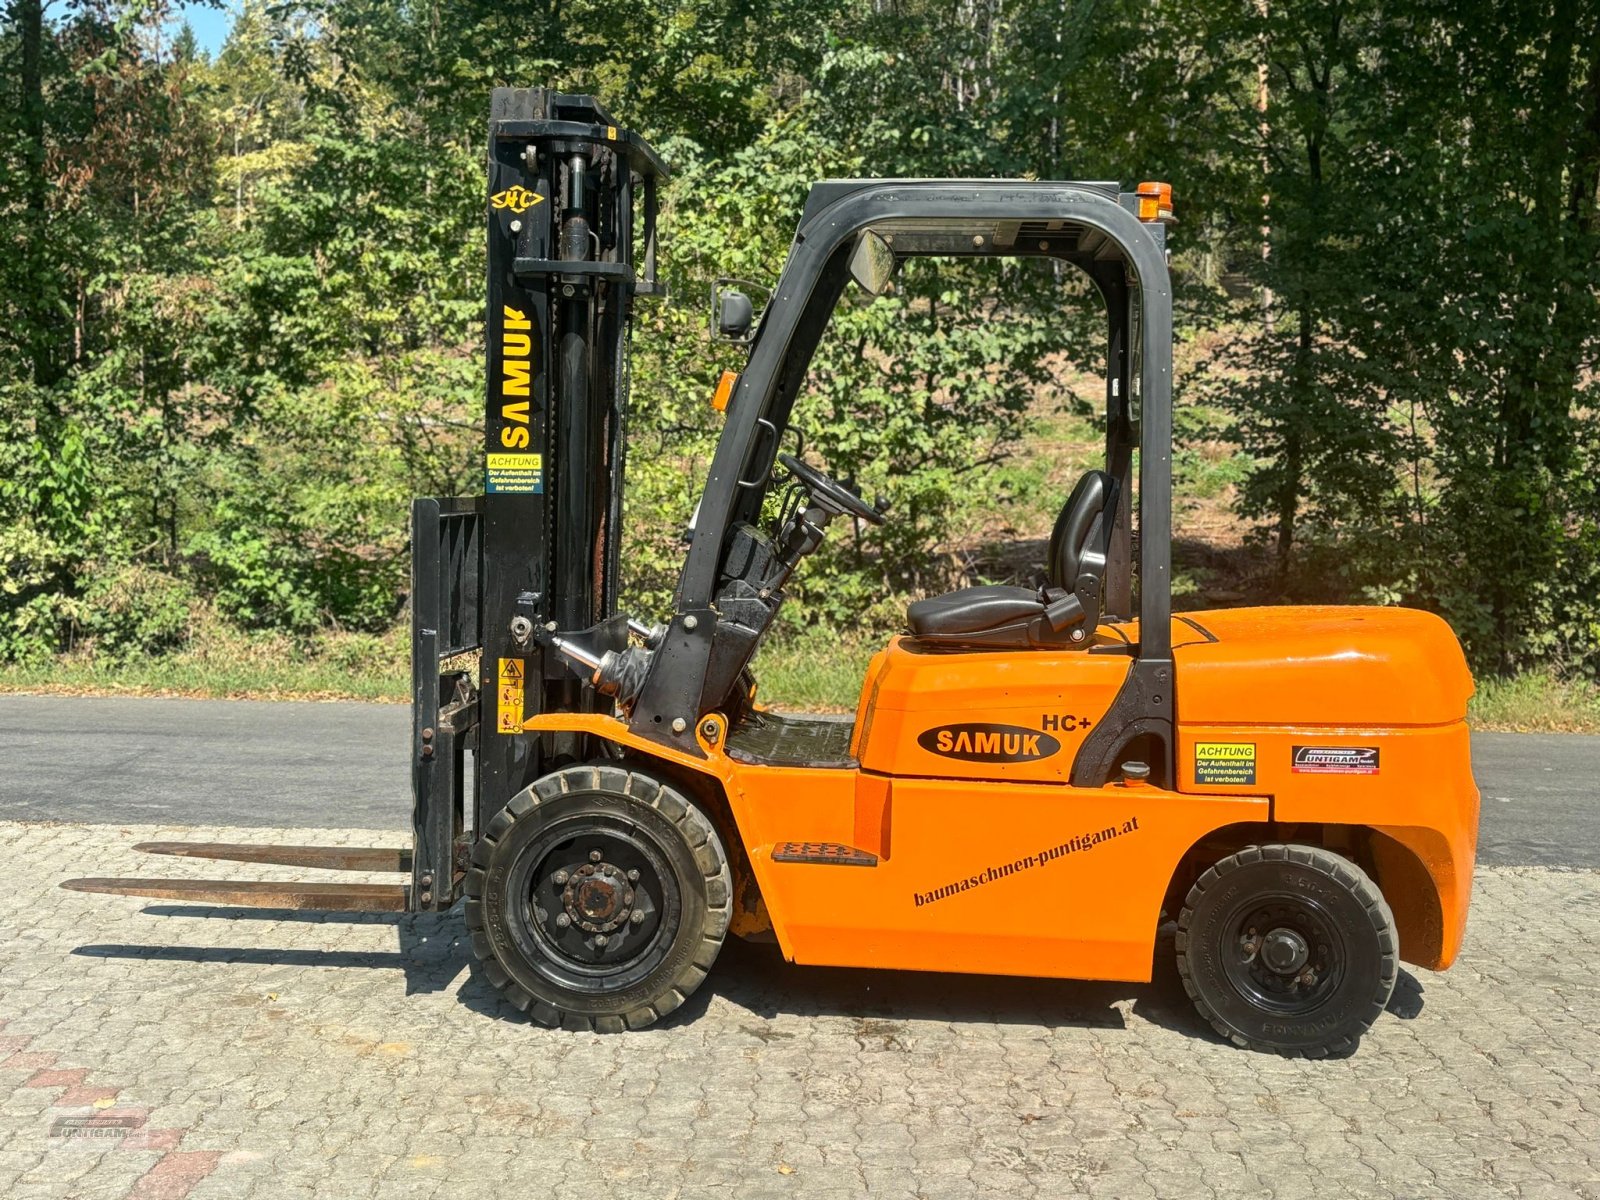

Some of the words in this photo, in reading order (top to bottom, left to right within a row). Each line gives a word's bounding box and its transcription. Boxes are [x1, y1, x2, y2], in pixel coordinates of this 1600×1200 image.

[501, 304, 531, 449] SAMUK
[490, 457, 539, 466] ACHTUNG
[1042, 714, 1092, 732] HC+
[936, 731, 1041, 756] SAMUK
[1198, 747, 1253, 756] ACHTUNG
[1198, 767, 1254, 775] Gefahrenbereich
[913, 816, 1139, 907] baumaschinen-puntigam.at
